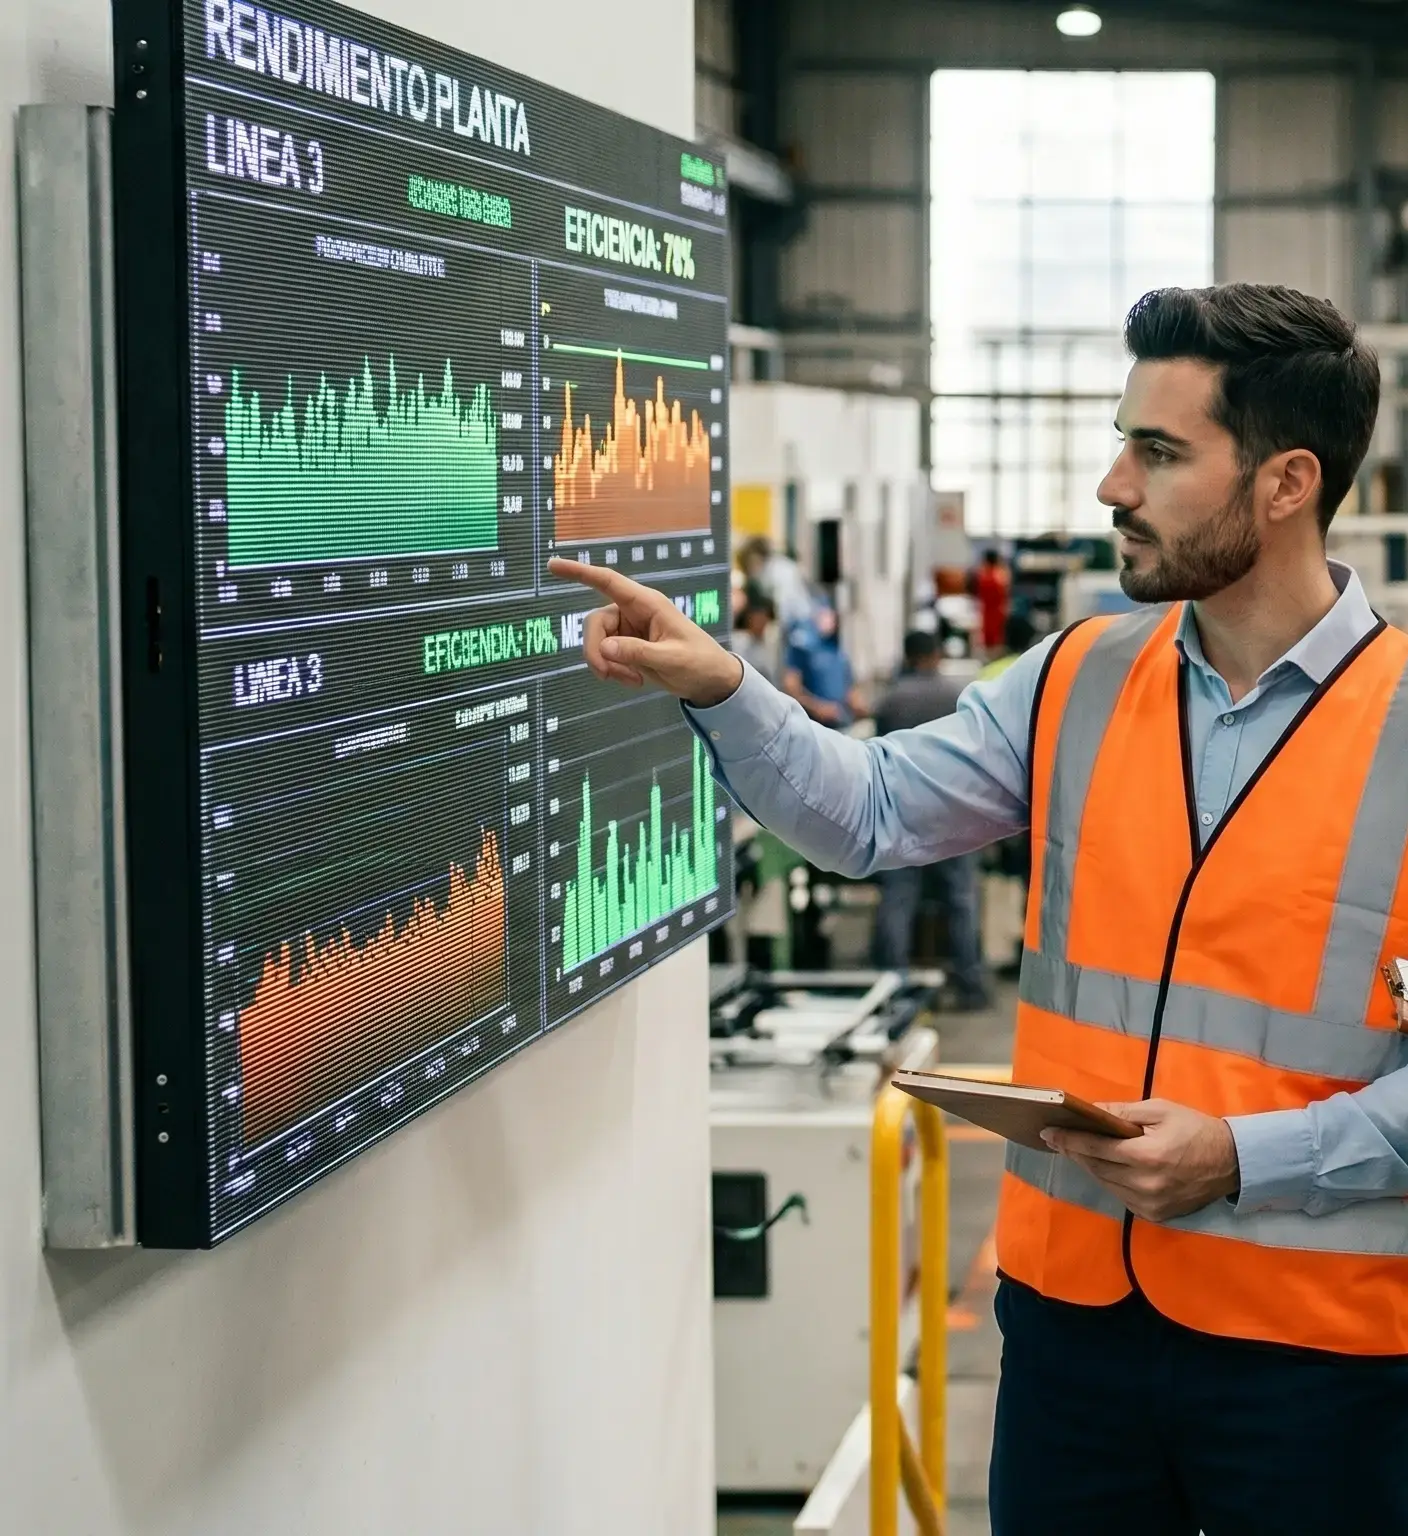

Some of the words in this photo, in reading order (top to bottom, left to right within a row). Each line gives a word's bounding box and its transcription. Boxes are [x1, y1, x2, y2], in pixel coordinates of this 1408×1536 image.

[205, 0, 428, 122] RENDIMIENTO
[435, 73, 531, 155] PLANTA
[207, 113, 300, 188] LINEA
[307, 141, 323, 193] 3
[565, 205, 662, 272] EFICIENCIA:
[306, 653, 322, 692] 3
